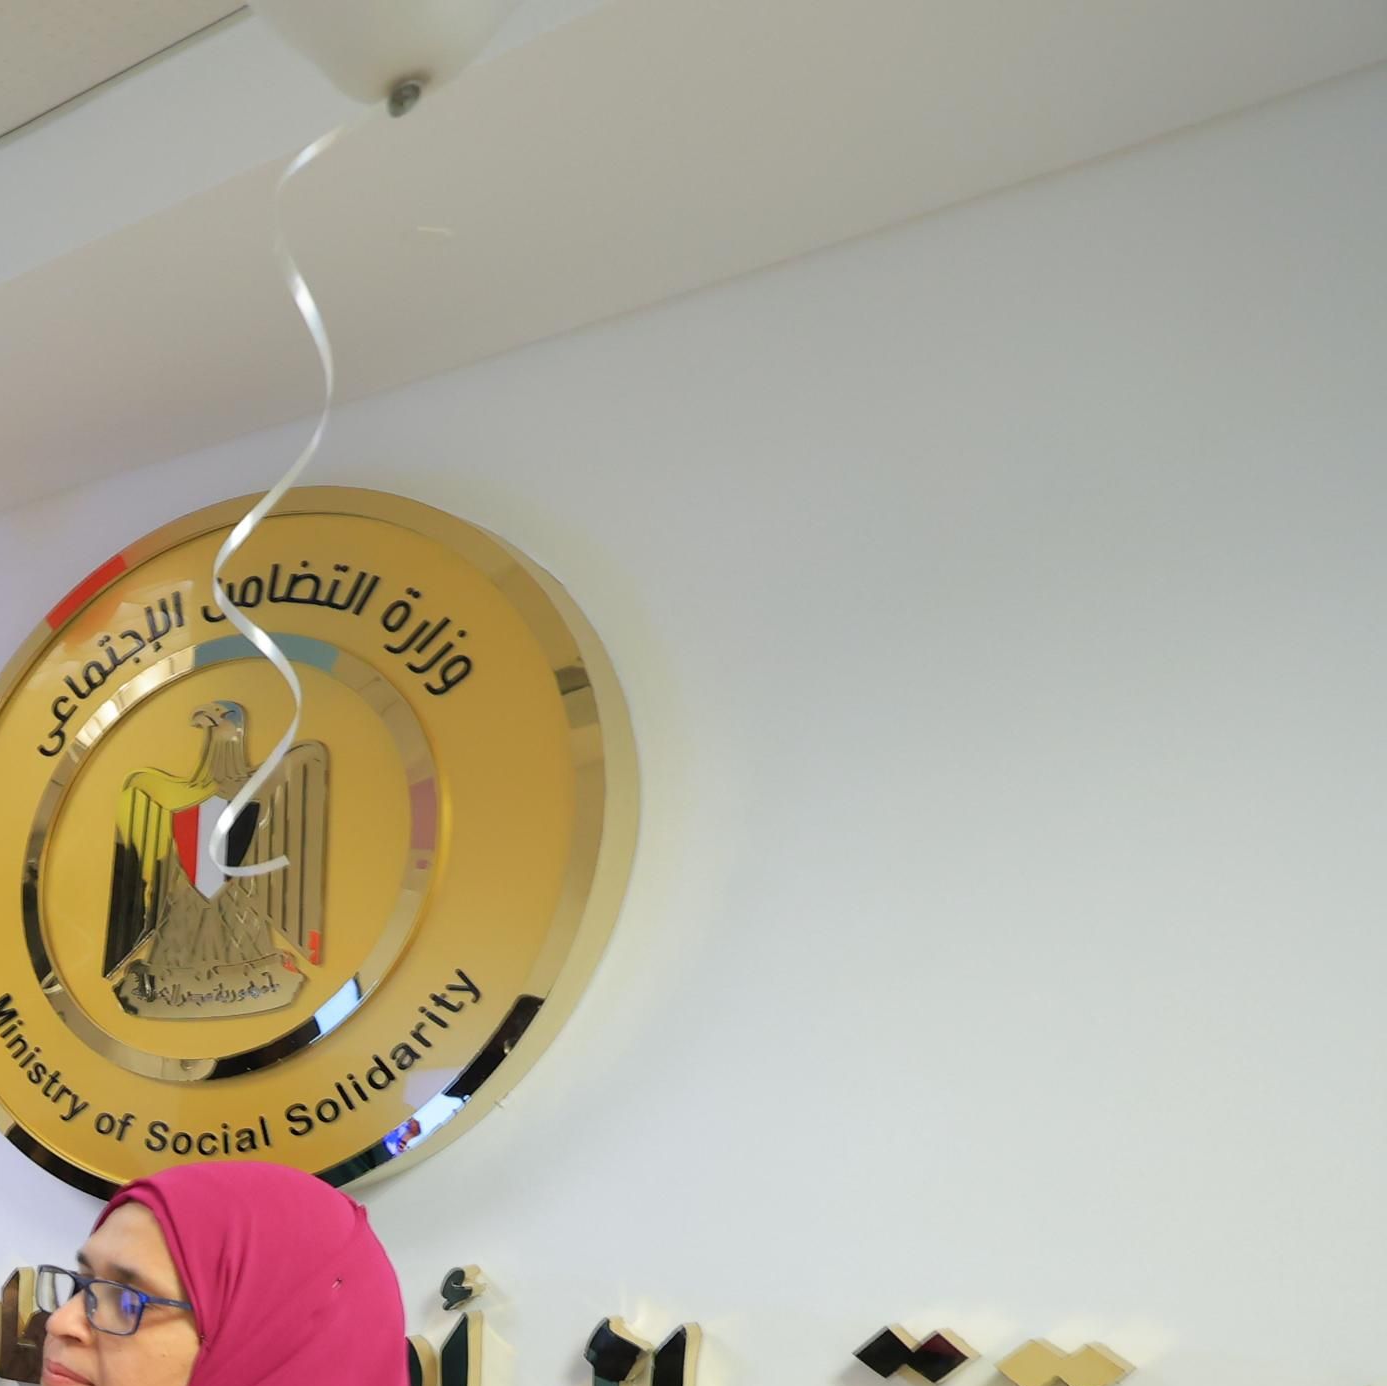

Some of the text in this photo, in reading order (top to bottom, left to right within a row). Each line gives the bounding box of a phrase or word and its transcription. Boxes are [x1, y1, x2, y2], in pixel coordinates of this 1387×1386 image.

[200, 559, 382, 624] التضامن
[380, 586, 474, 697] وزارة
[95, 1110, 135, 1143] of
[144, 1115, 272, 1157] Social
[283, 967, 482, 1138] Solidarity
